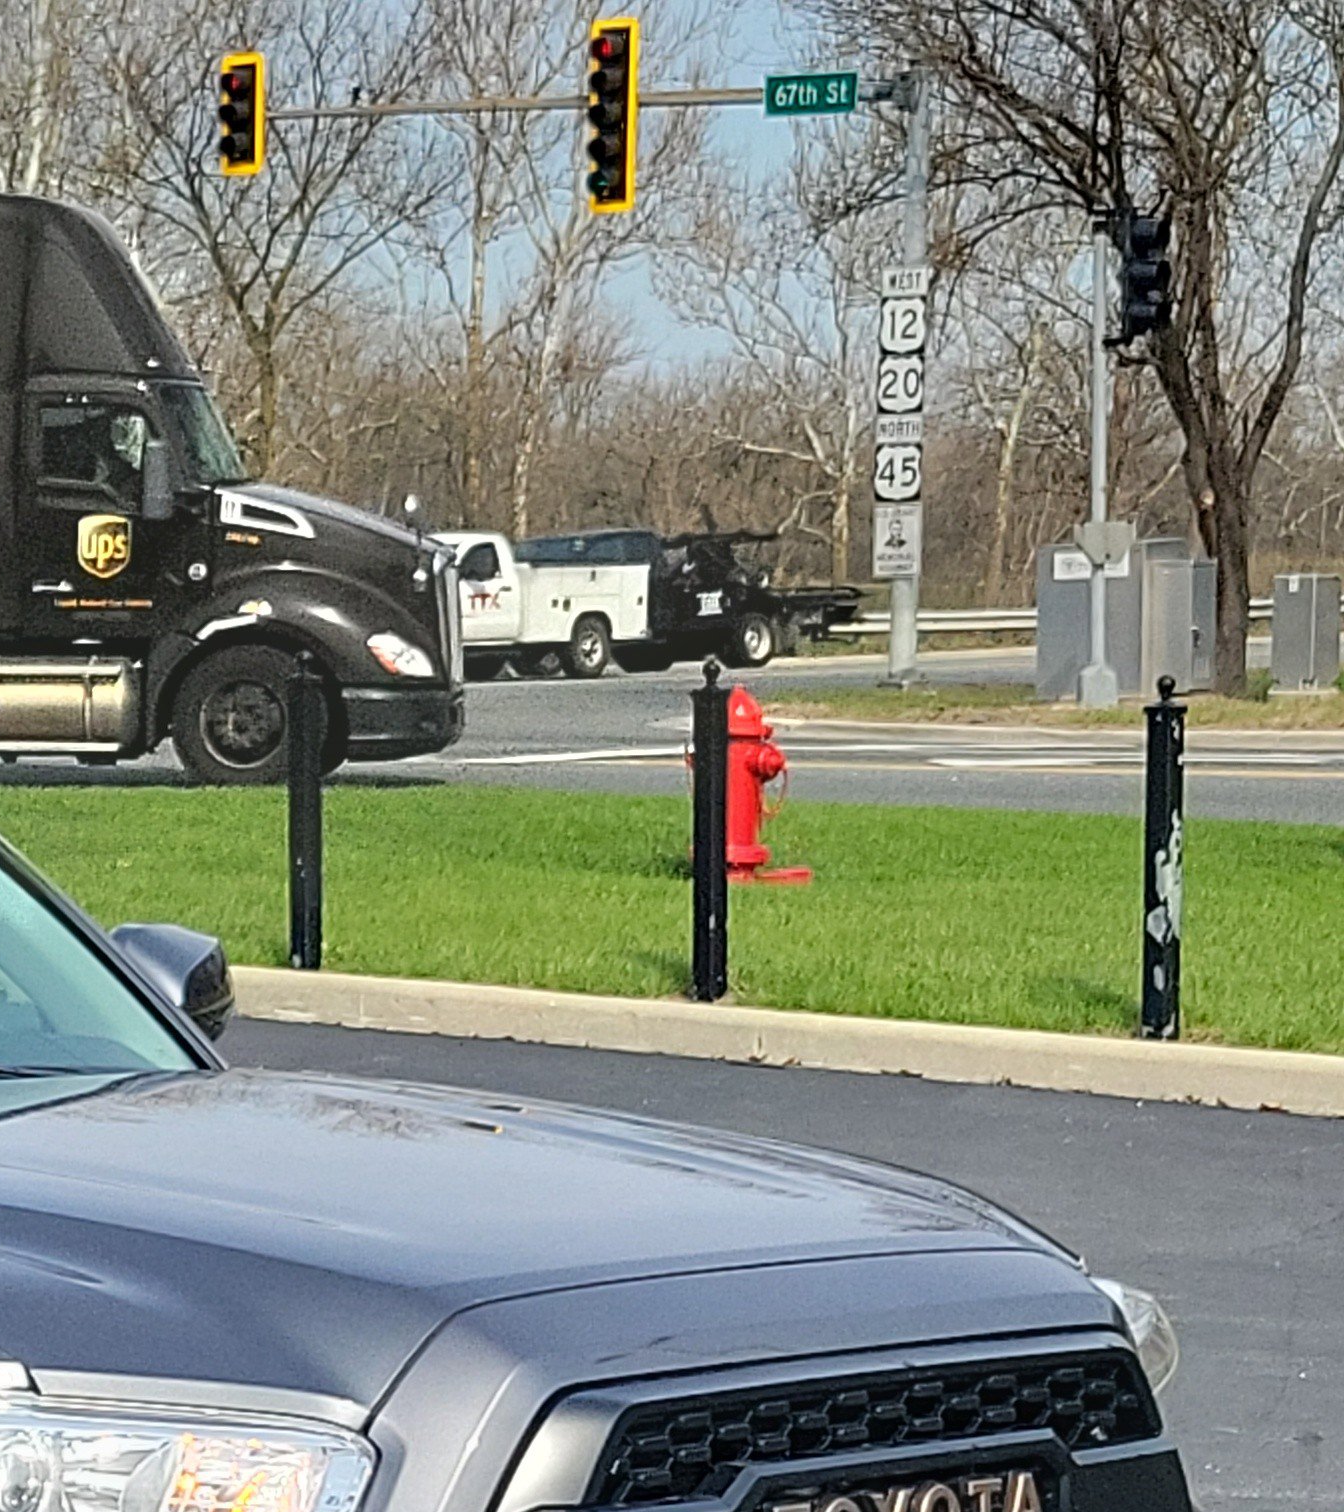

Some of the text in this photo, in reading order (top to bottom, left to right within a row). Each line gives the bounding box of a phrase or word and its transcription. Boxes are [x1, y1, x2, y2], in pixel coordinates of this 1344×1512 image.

[775, 79, 849, 107] 67th St
[888, 271, 922, 290] WEST
[889, 308, 917, 341] 12
[881, 368, 920, 399] 20
[879, 421, 920, 438] NORTH
[878, 456, 917, 488] 45
[81, 532, 127, 570] ups
[468, 593, 501, 610] TTX
